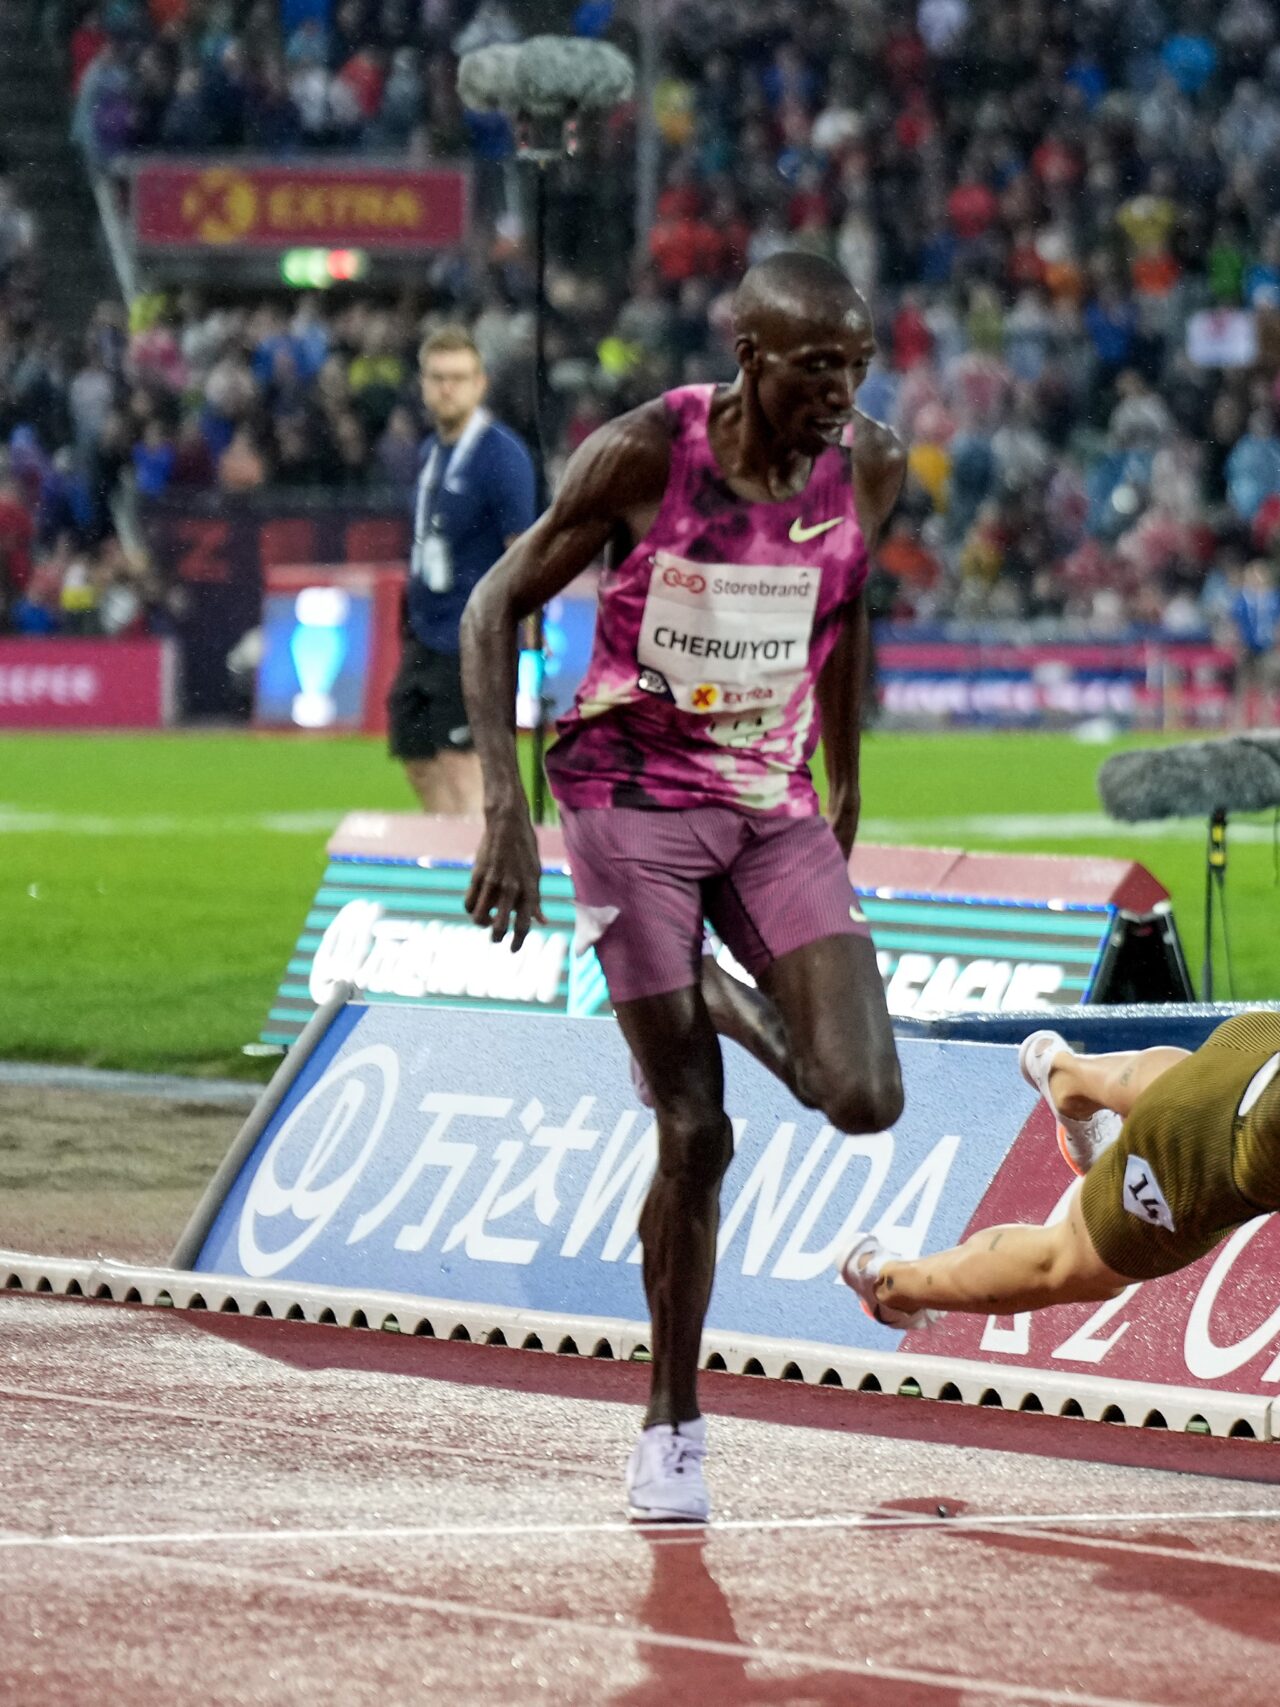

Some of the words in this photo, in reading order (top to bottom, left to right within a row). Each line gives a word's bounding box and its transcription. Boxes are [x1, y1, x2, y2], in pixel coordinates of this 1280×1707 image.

[712, 578, 810, 598] Storebrand
[653, 626, 796, 661] CHERUIYOT
[562, 1109, 962, 1285] WNDA
[1128, 1173, 1160, 1219] 14
